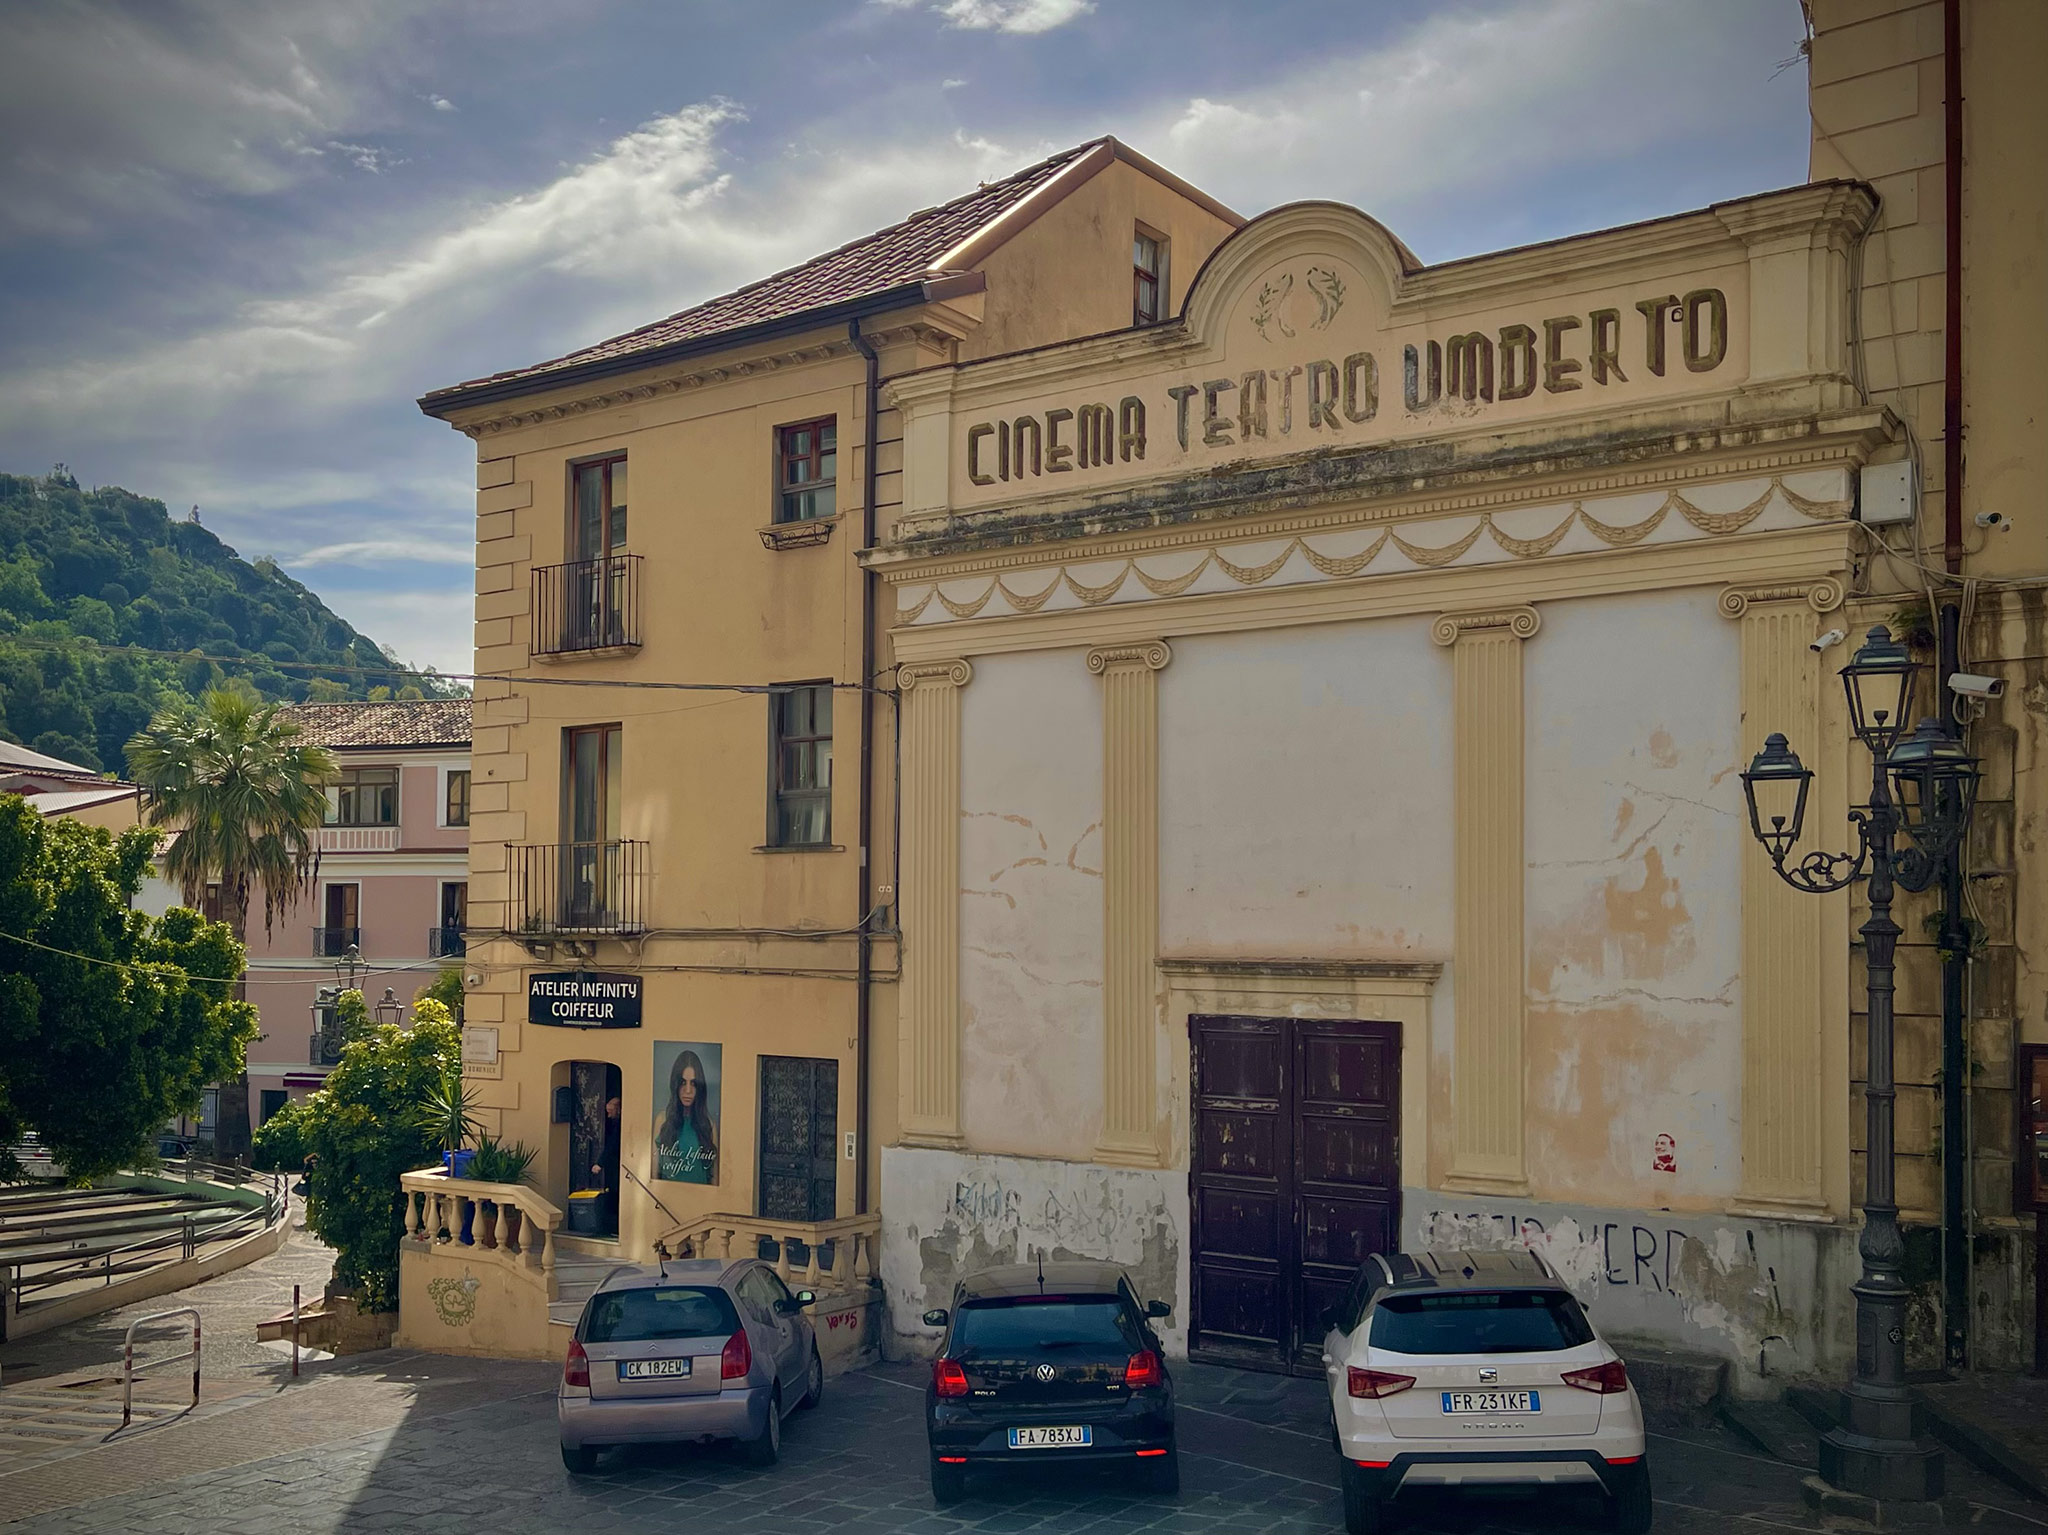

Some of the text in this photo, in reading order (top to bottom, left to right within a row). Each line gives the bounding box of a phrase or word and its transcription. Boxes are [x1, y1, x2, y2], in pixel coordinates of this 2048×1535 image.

[967, 396, 1147, 486] CINEMA
[1167, 352, 1379, 452] TEATRO
[531, 981, 637, 999] ATELIER INFINITY
[551, 1001, 614, 1019] COIFFEUR
[628, 1361, 642, 1375] CK
